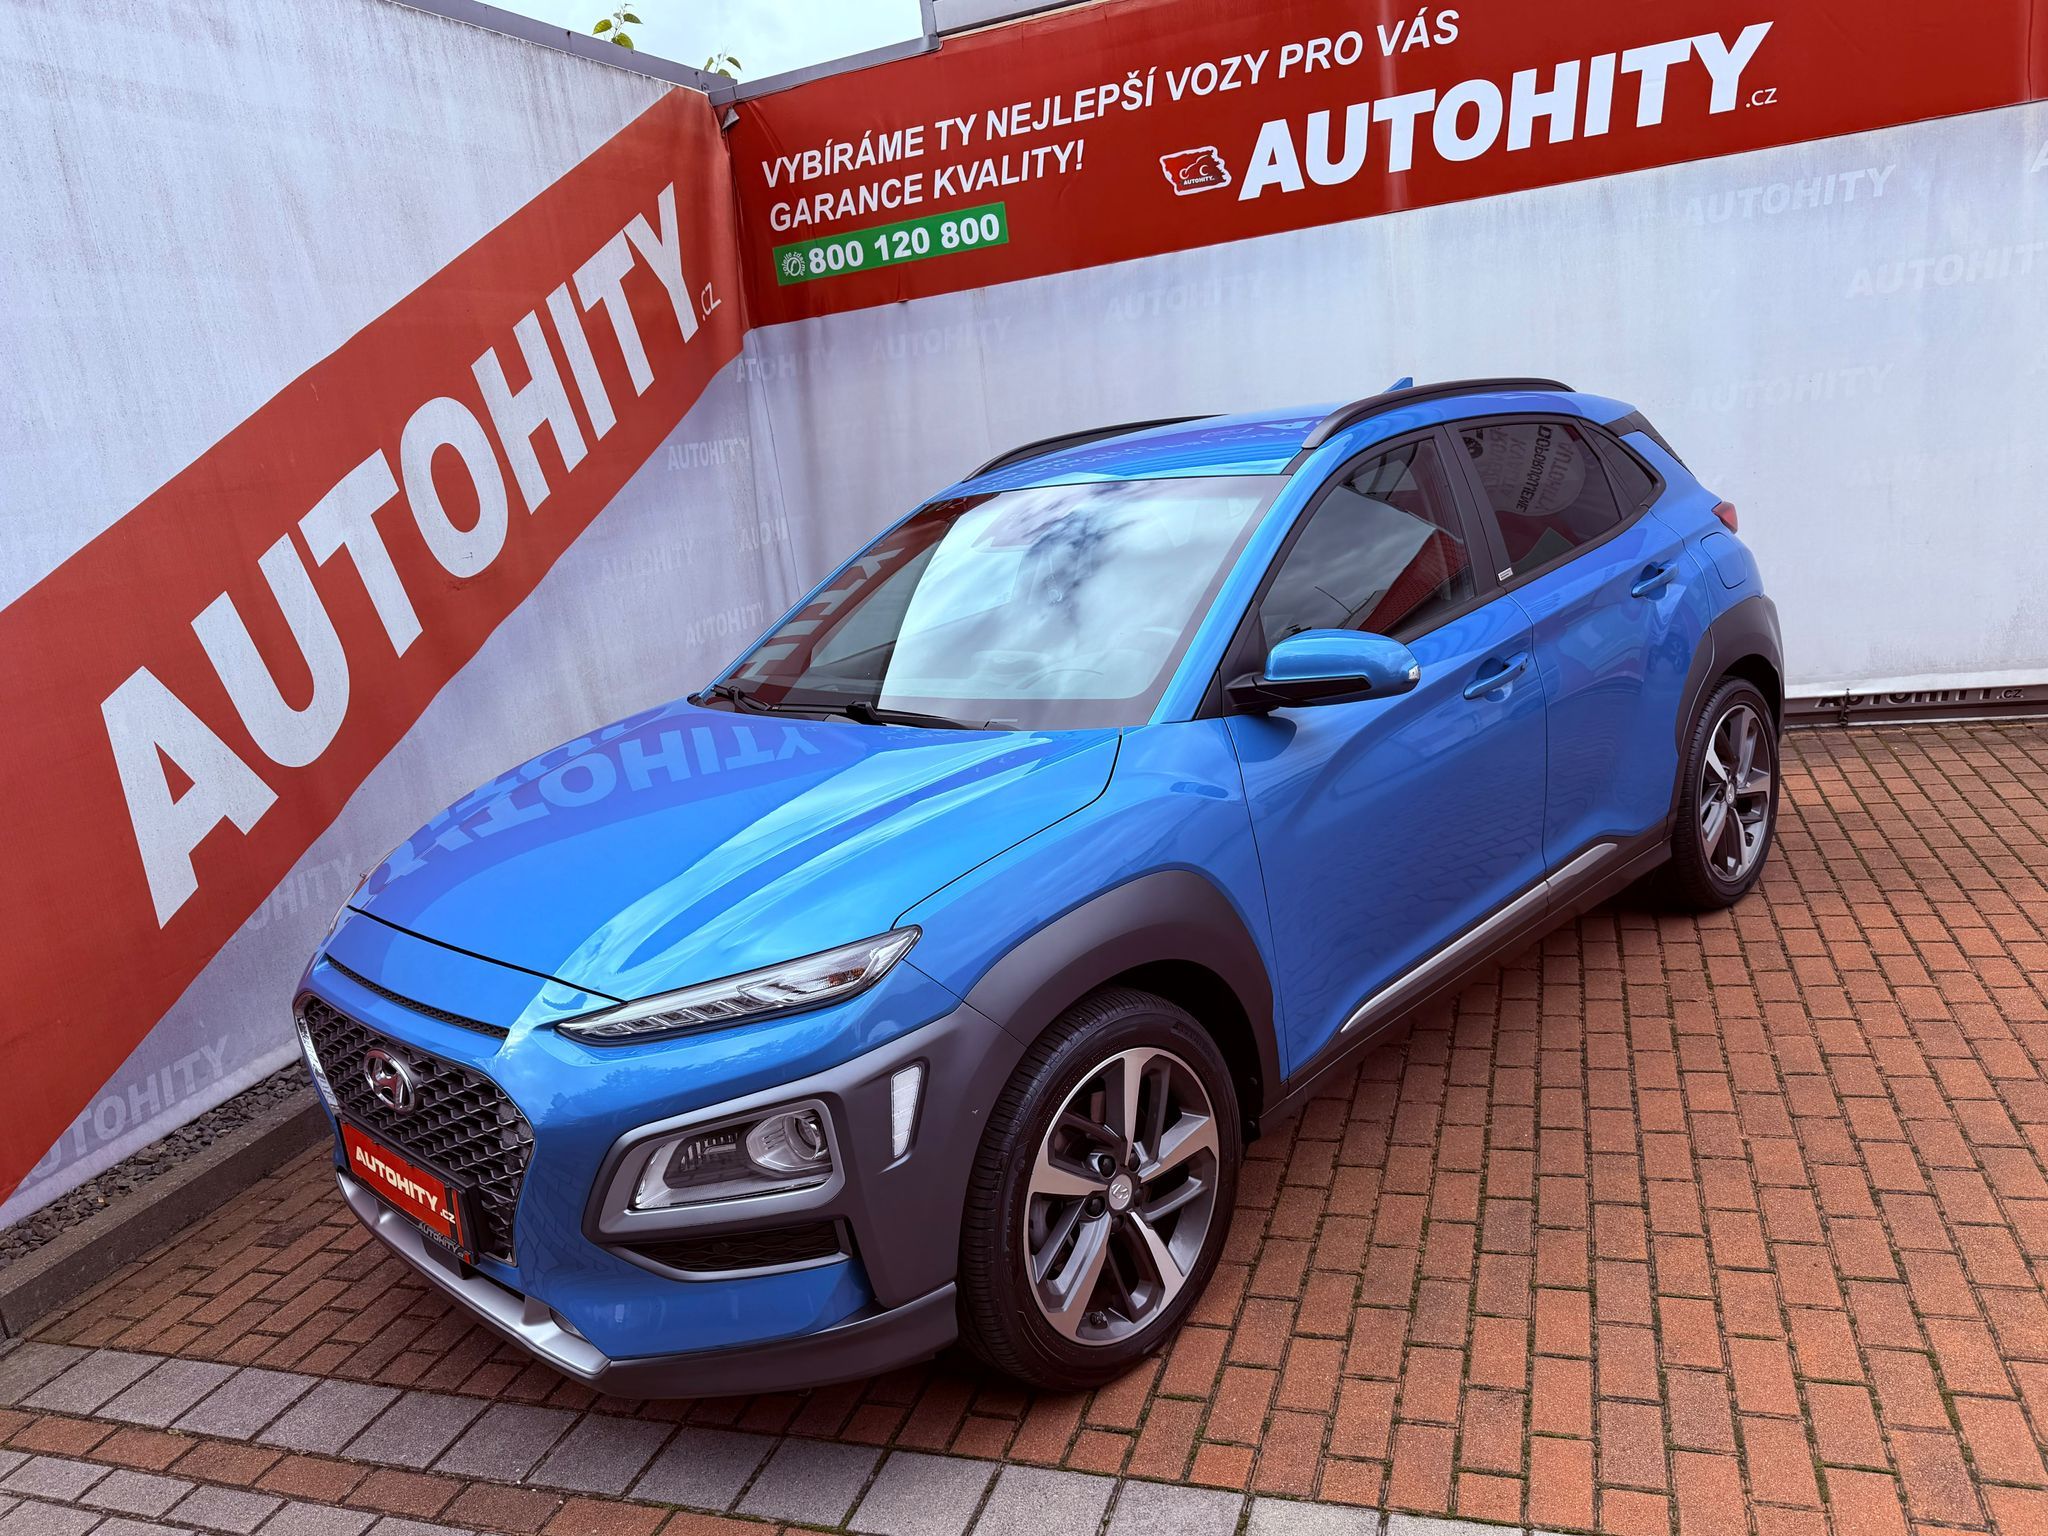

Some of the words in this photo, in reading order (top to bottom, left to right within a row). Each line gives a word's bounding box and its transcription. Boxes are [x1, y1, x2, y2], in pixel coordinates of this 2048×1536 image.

[761, 124, 926, 189] VYBÍRÁME
[935, 113, 979, 147] TY
[986, 71, 1156, 138] NEJLEPŠÍ
[1165, 48, 1270, 102] VOZY
[1278, 30, 1363, 80] PRO
[1376, 7, 1460, 58] VÁS
[769, 180, 926, 232] GARANCE
[933, 139, 1085, 200] KVALITY!
[807, 240, 865, 275] 800
[873, 227, 930, 263] 120
[940, 213, 1000, 250] 800
[1845, 241, 2048, 300] AUTOHIT
[22, 1035, 229, 1190] UTOHITY
